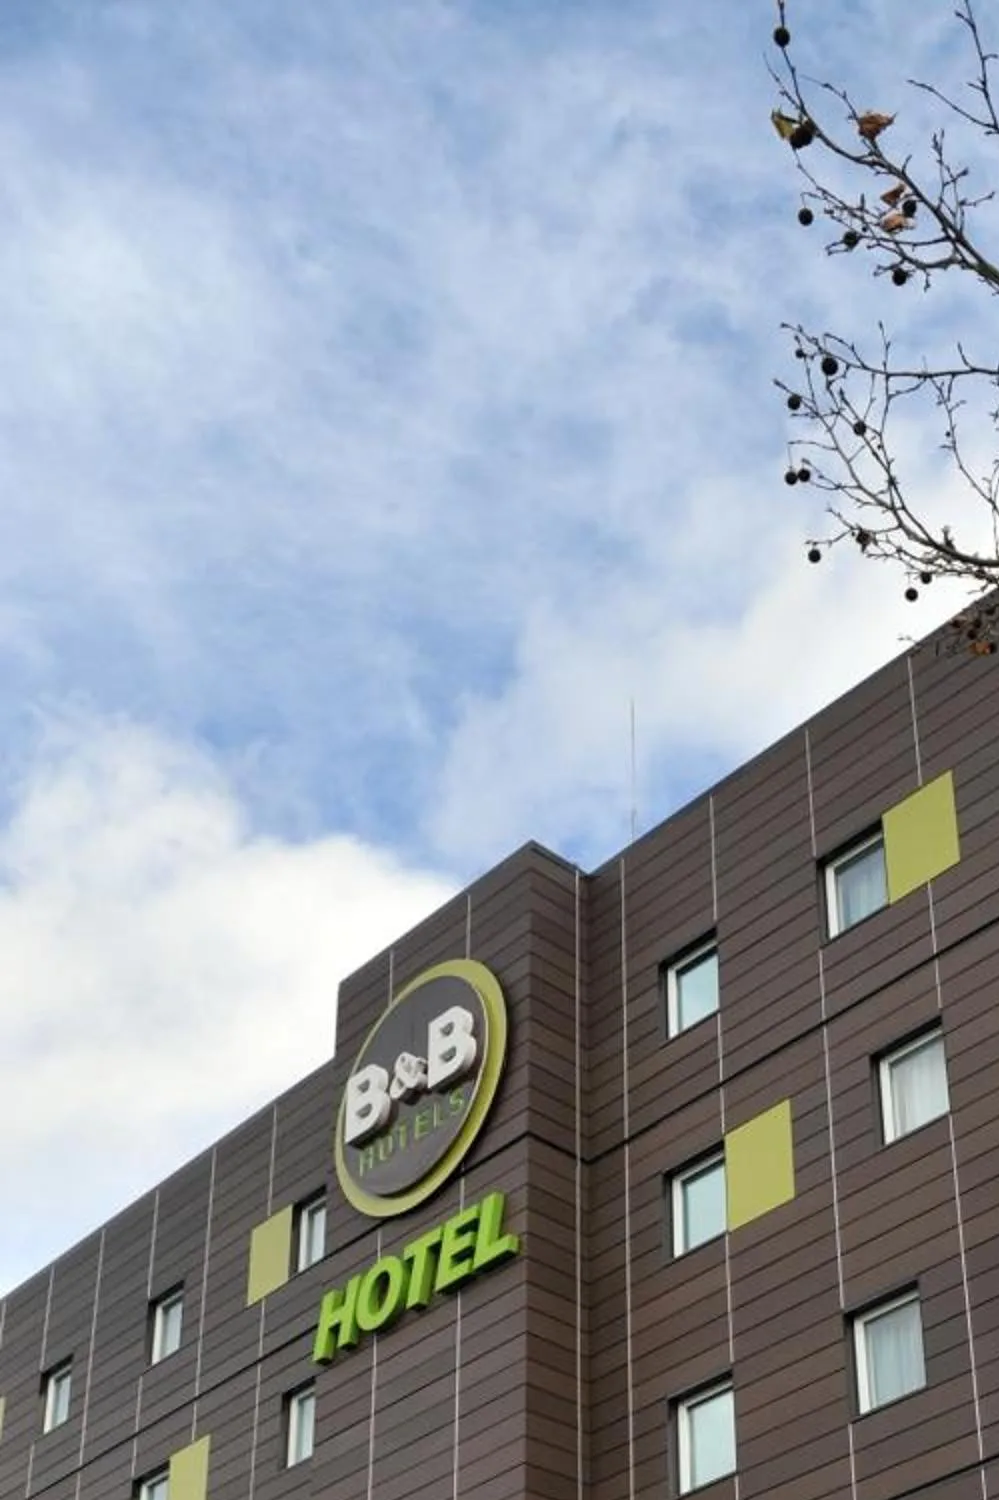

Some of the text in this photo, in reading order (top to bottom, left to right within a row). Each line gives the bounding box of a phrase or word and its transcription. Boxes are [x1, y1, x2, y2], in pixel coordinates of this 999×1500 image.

[345, 1005, 477, 1145] B&B
[358, 1087, 465, 1178] HOTELS
[313, 1192, 521, 1365] HOTEL
